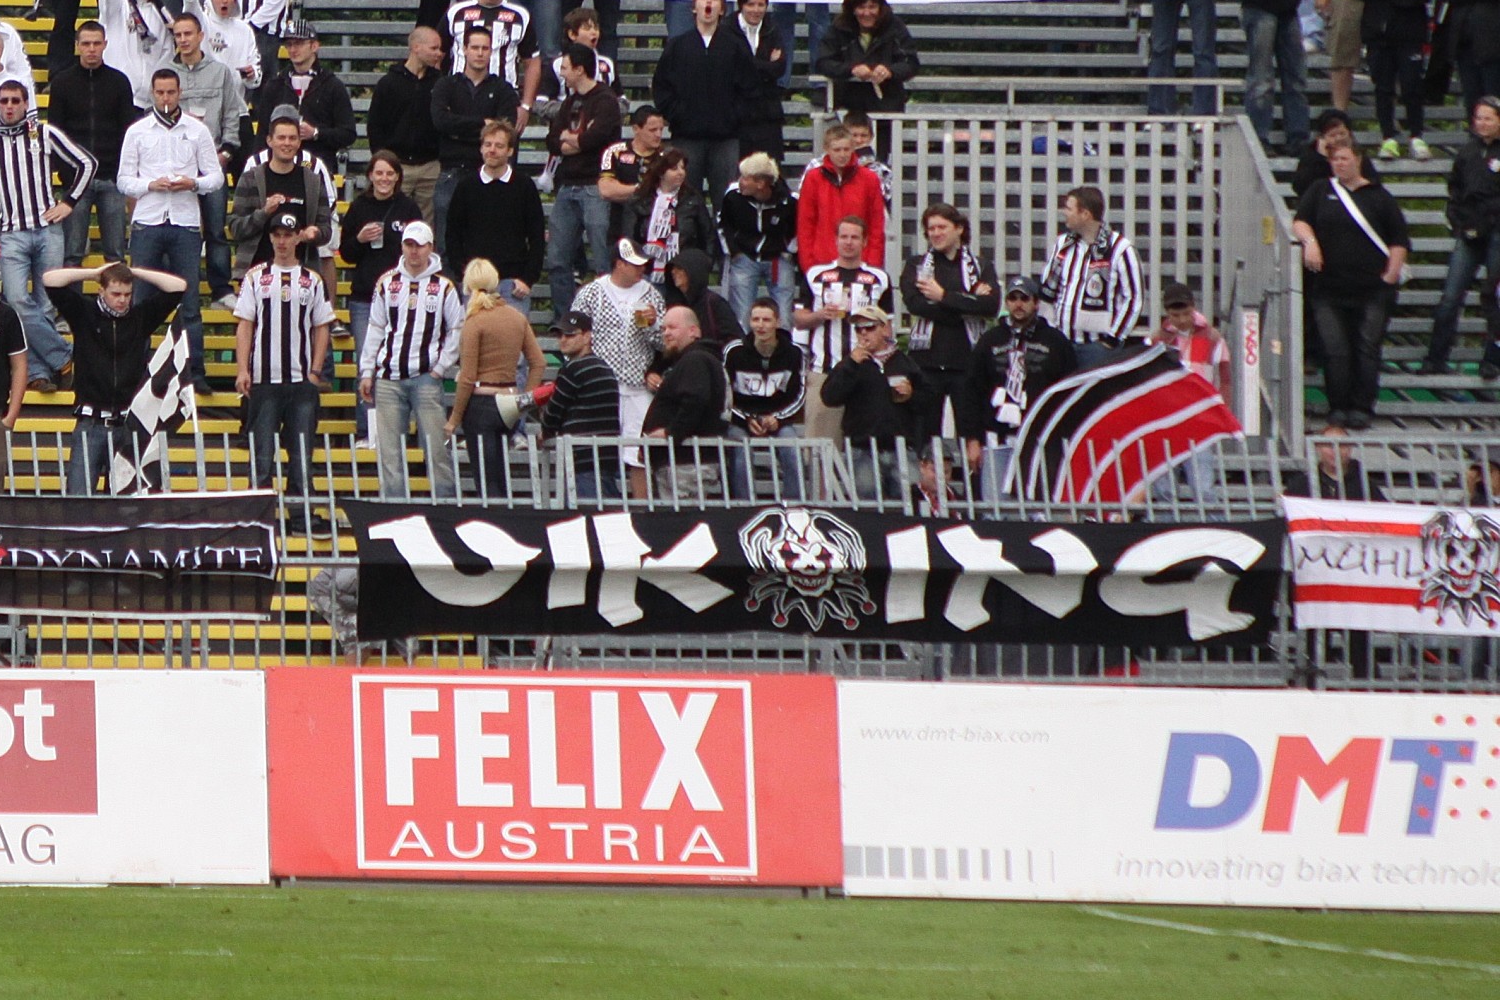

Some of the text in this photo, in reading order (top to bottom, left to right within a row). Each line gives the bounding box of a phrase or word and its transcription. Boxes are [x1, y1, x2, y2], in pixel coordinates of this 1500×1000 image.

[11, 545, 268, 572] DYNAMITE
[382, 686, 724, 812] FELIX
[860, 726, 1051, 745] www.dmt-biax.com
[1153, 731, 1478, 837] DMT
[389, 821, 725, 863] AUSTRIA
[1114, 853, 1285, 888] innovating
[1296, 856, 1361, 884] biax
